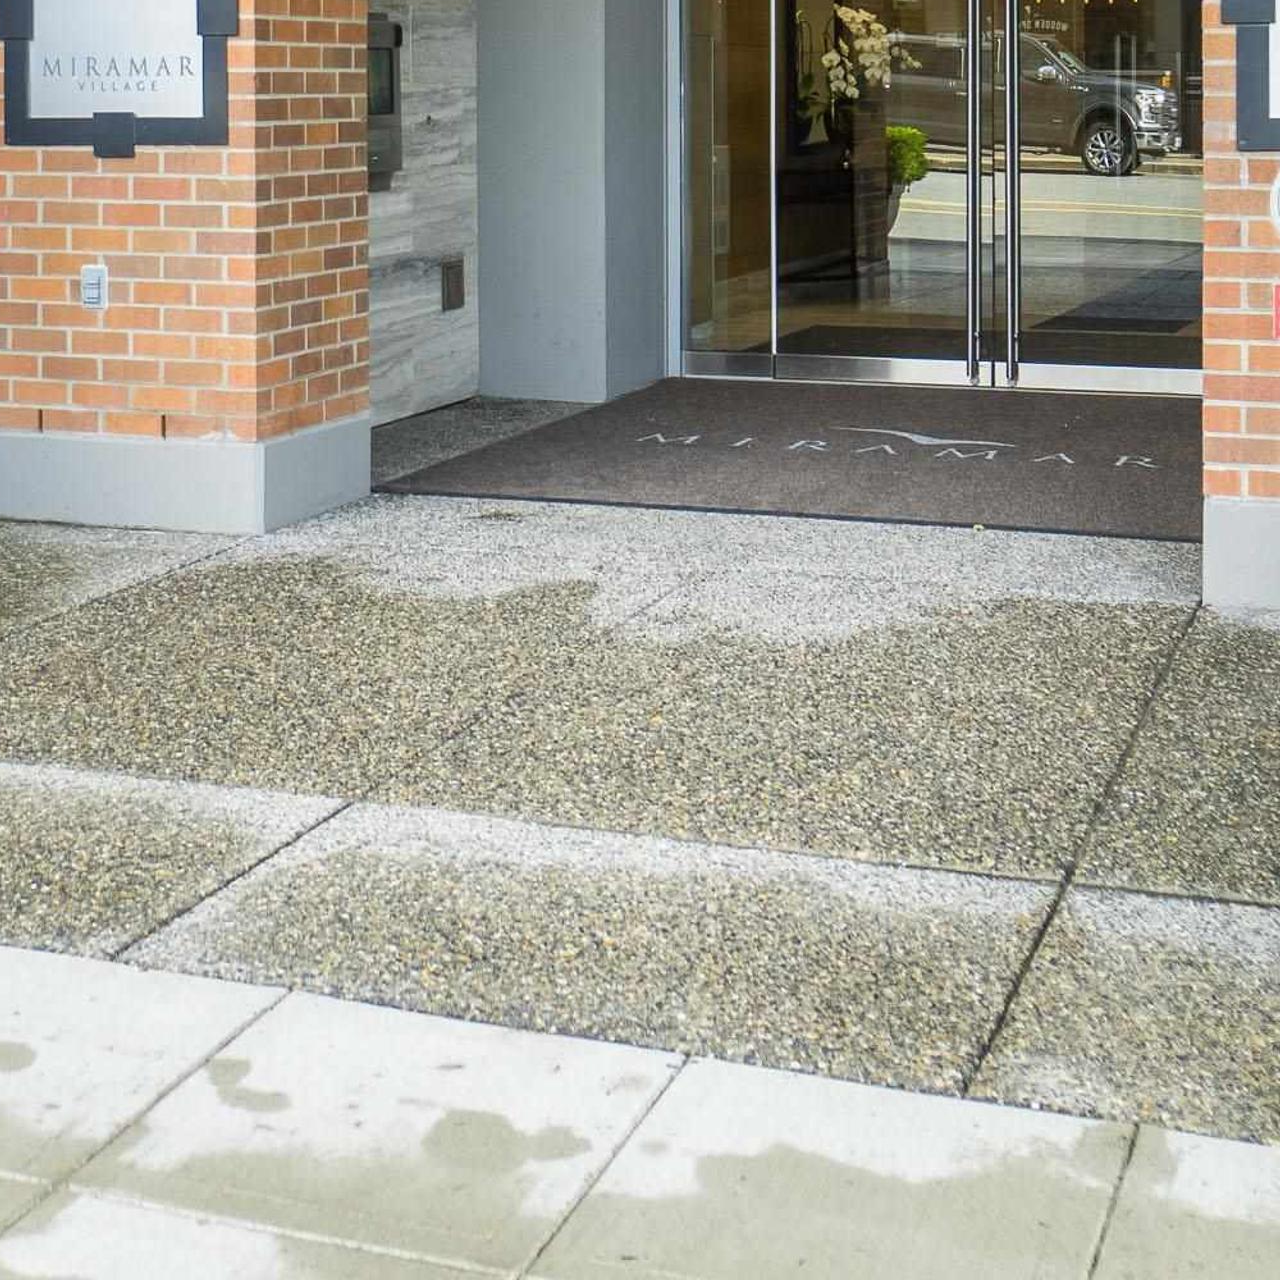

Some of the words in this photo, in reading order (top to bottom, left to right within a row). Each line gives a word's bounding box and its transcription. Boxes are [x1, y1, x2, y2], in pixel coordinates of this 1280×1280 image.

[42, 55, 196, 77] MIRAMAR
[78, 80, 159, 92] VILLAGE
[636, 432, 1162, 469] MIRAMAR
